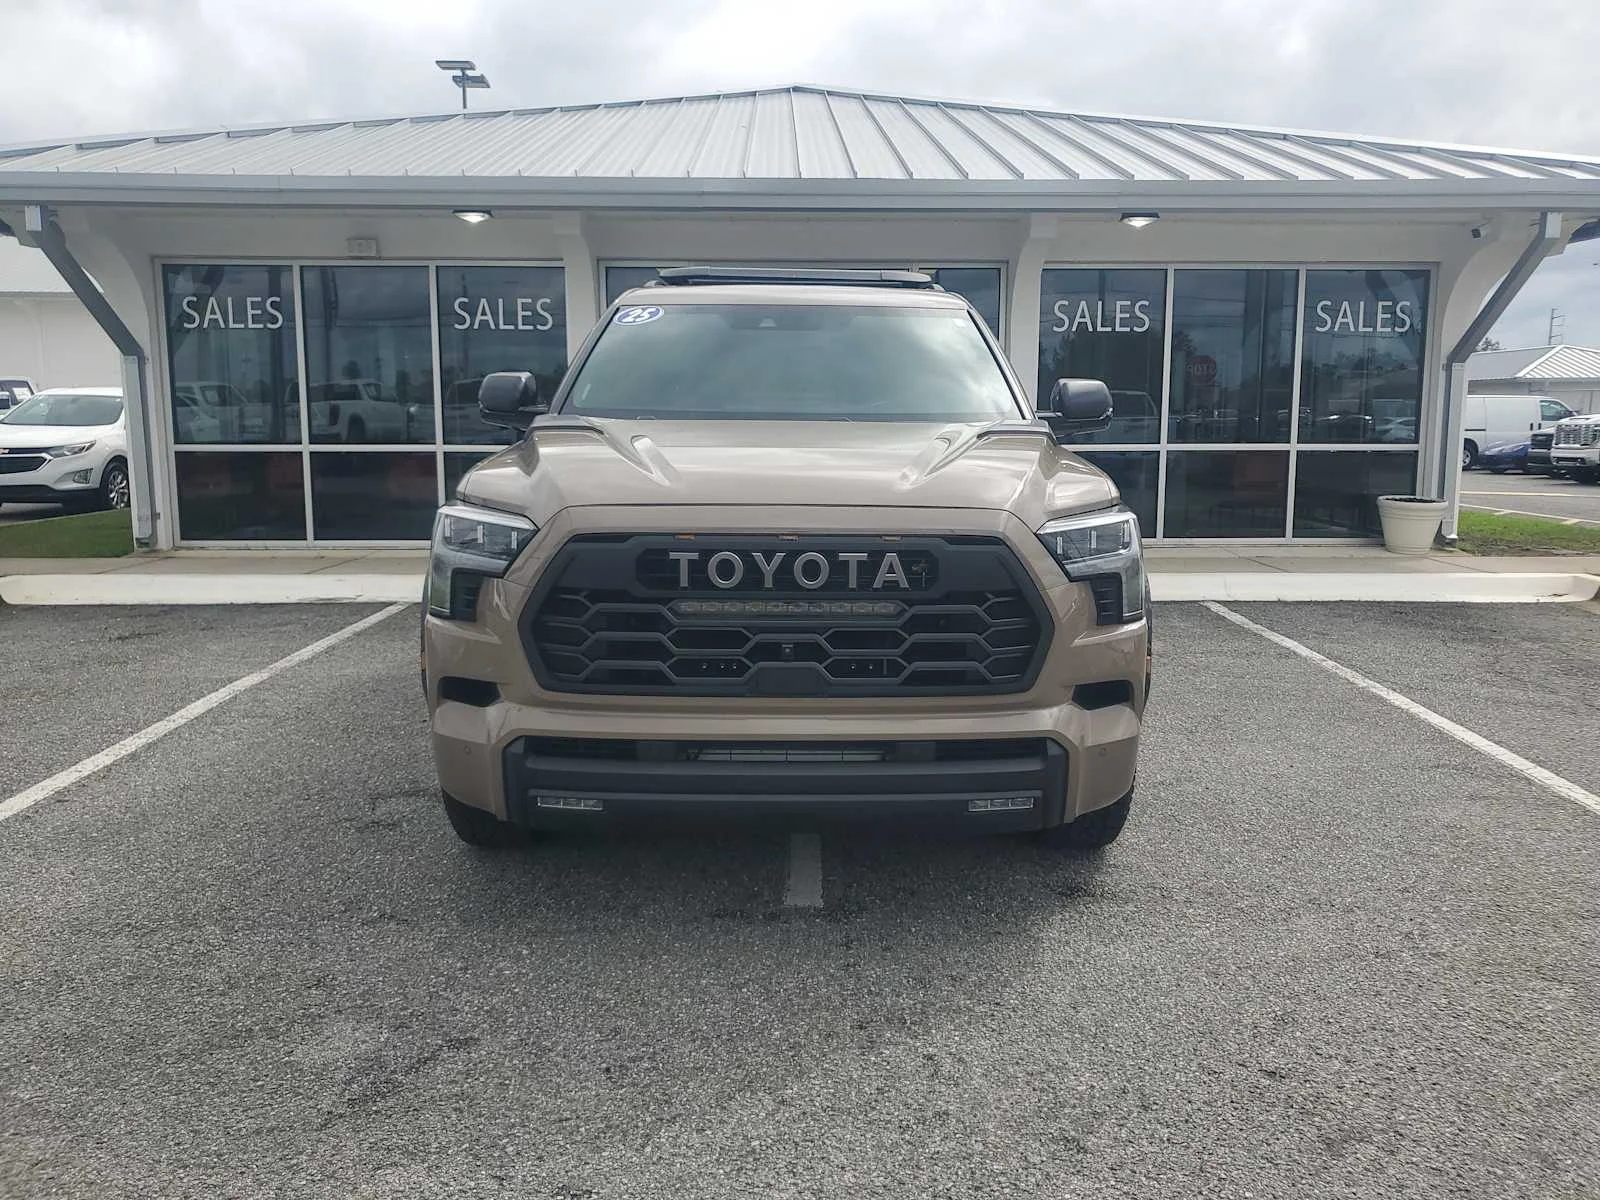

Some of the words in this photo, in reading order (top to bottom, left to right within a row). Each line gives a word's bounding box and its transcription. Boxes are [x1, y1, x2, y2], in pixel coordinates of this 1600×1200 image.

[182, 296, 283, 329] SALES
[454, 297, 553, 330] SALES
[622, 308, 657, 322] 25
[1052, 300, 1150, 332] SALES
[1315, 300, 1411, 332] SALES
[669, 551, 909, 589] TOYOTA
